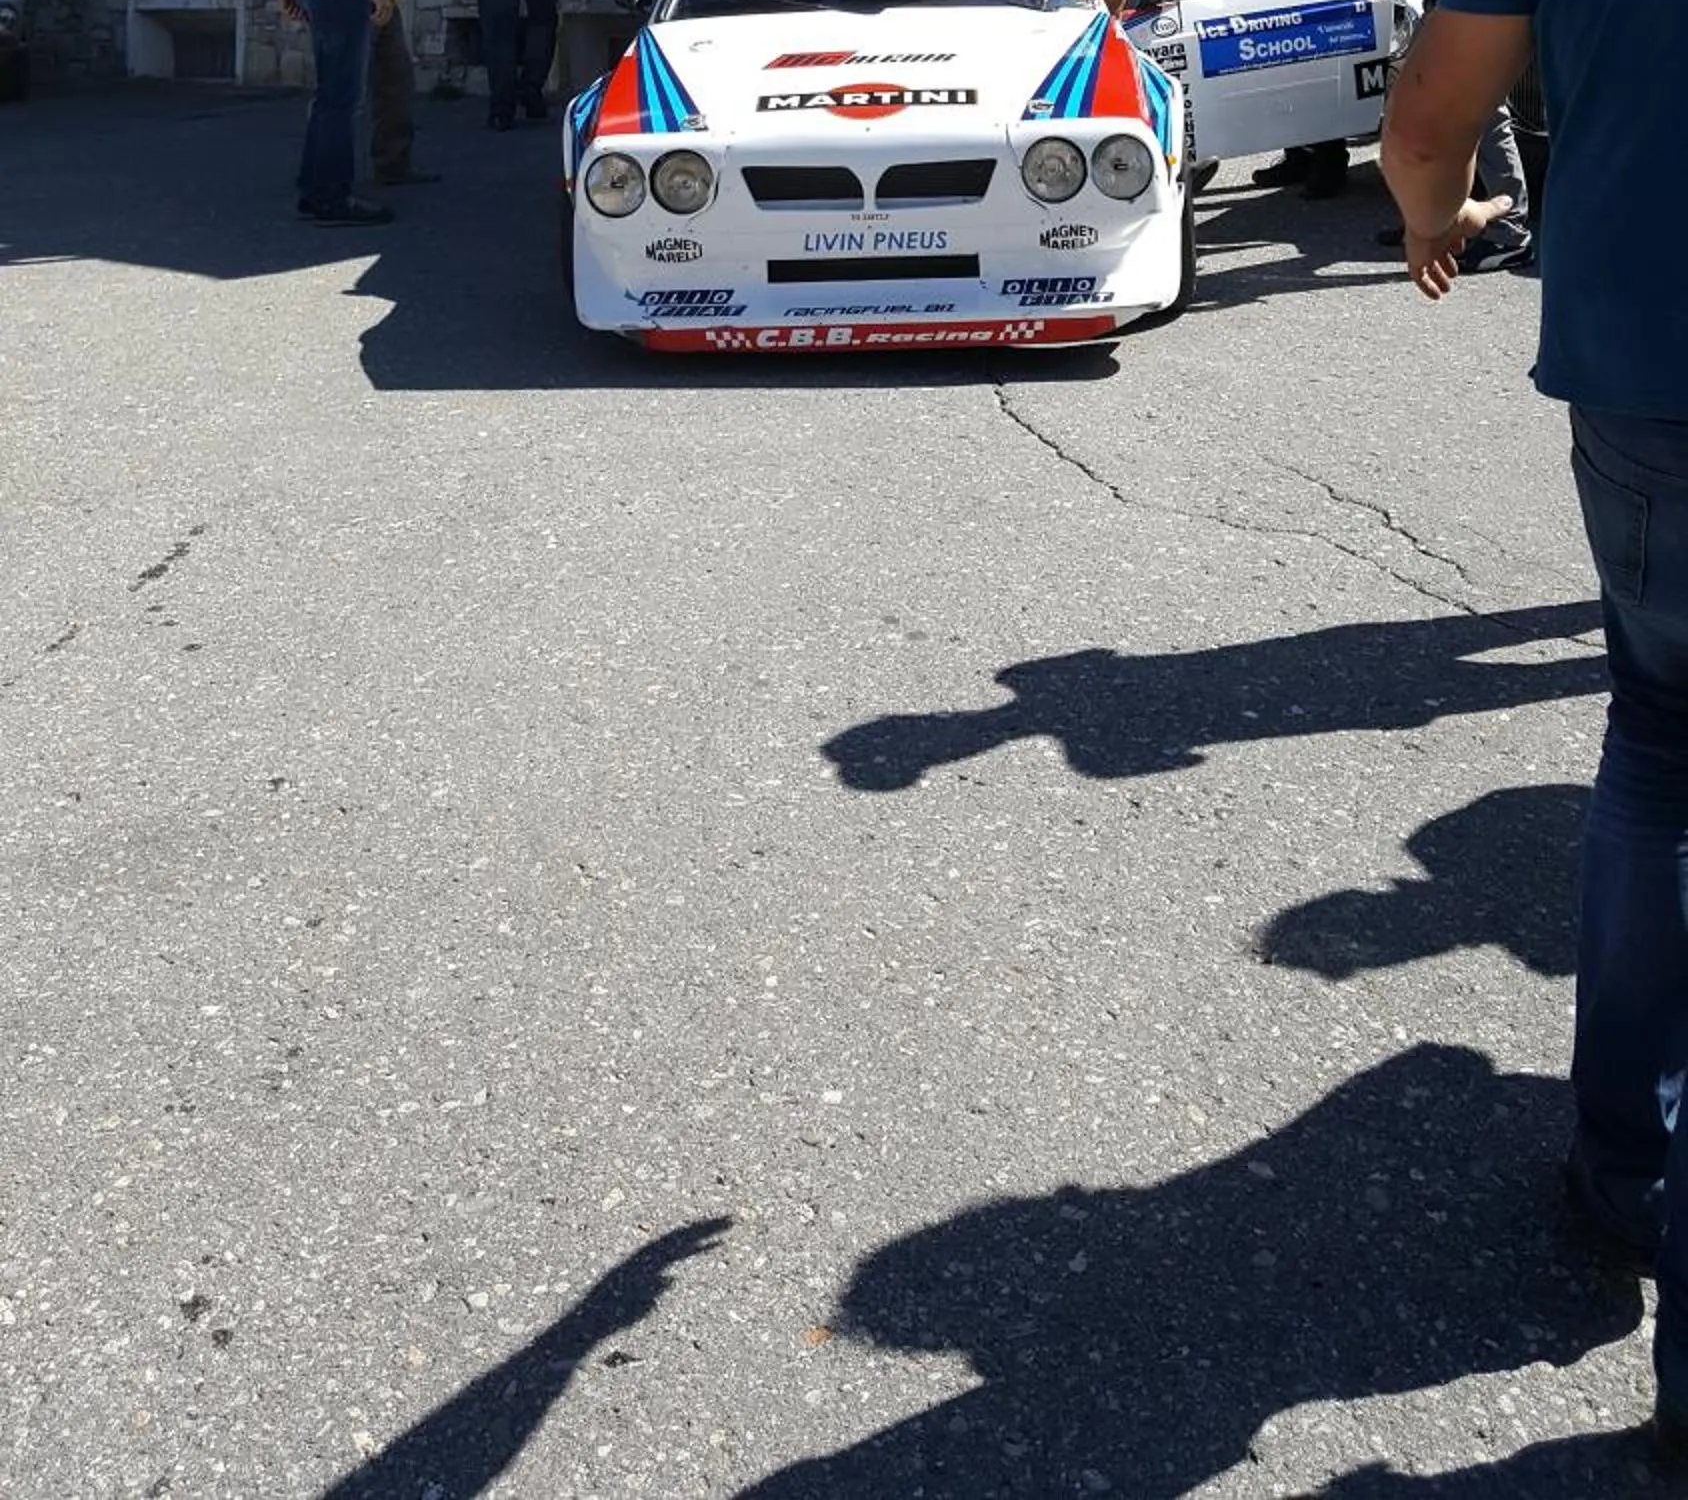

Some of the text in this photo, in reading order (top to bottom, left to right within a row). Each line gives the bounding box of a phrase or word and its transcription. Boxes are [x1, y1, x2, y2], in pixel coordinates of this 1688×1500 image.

[1239, 35, 1316, 61] SCHOOL
[767, 91, 968, 109] MARTINI
[803, 231, 948, 252] LIVIN PNEUS
[1004, 279, 1093, 293] OLIO
[756, 327, 861, 347] C.B.B.
